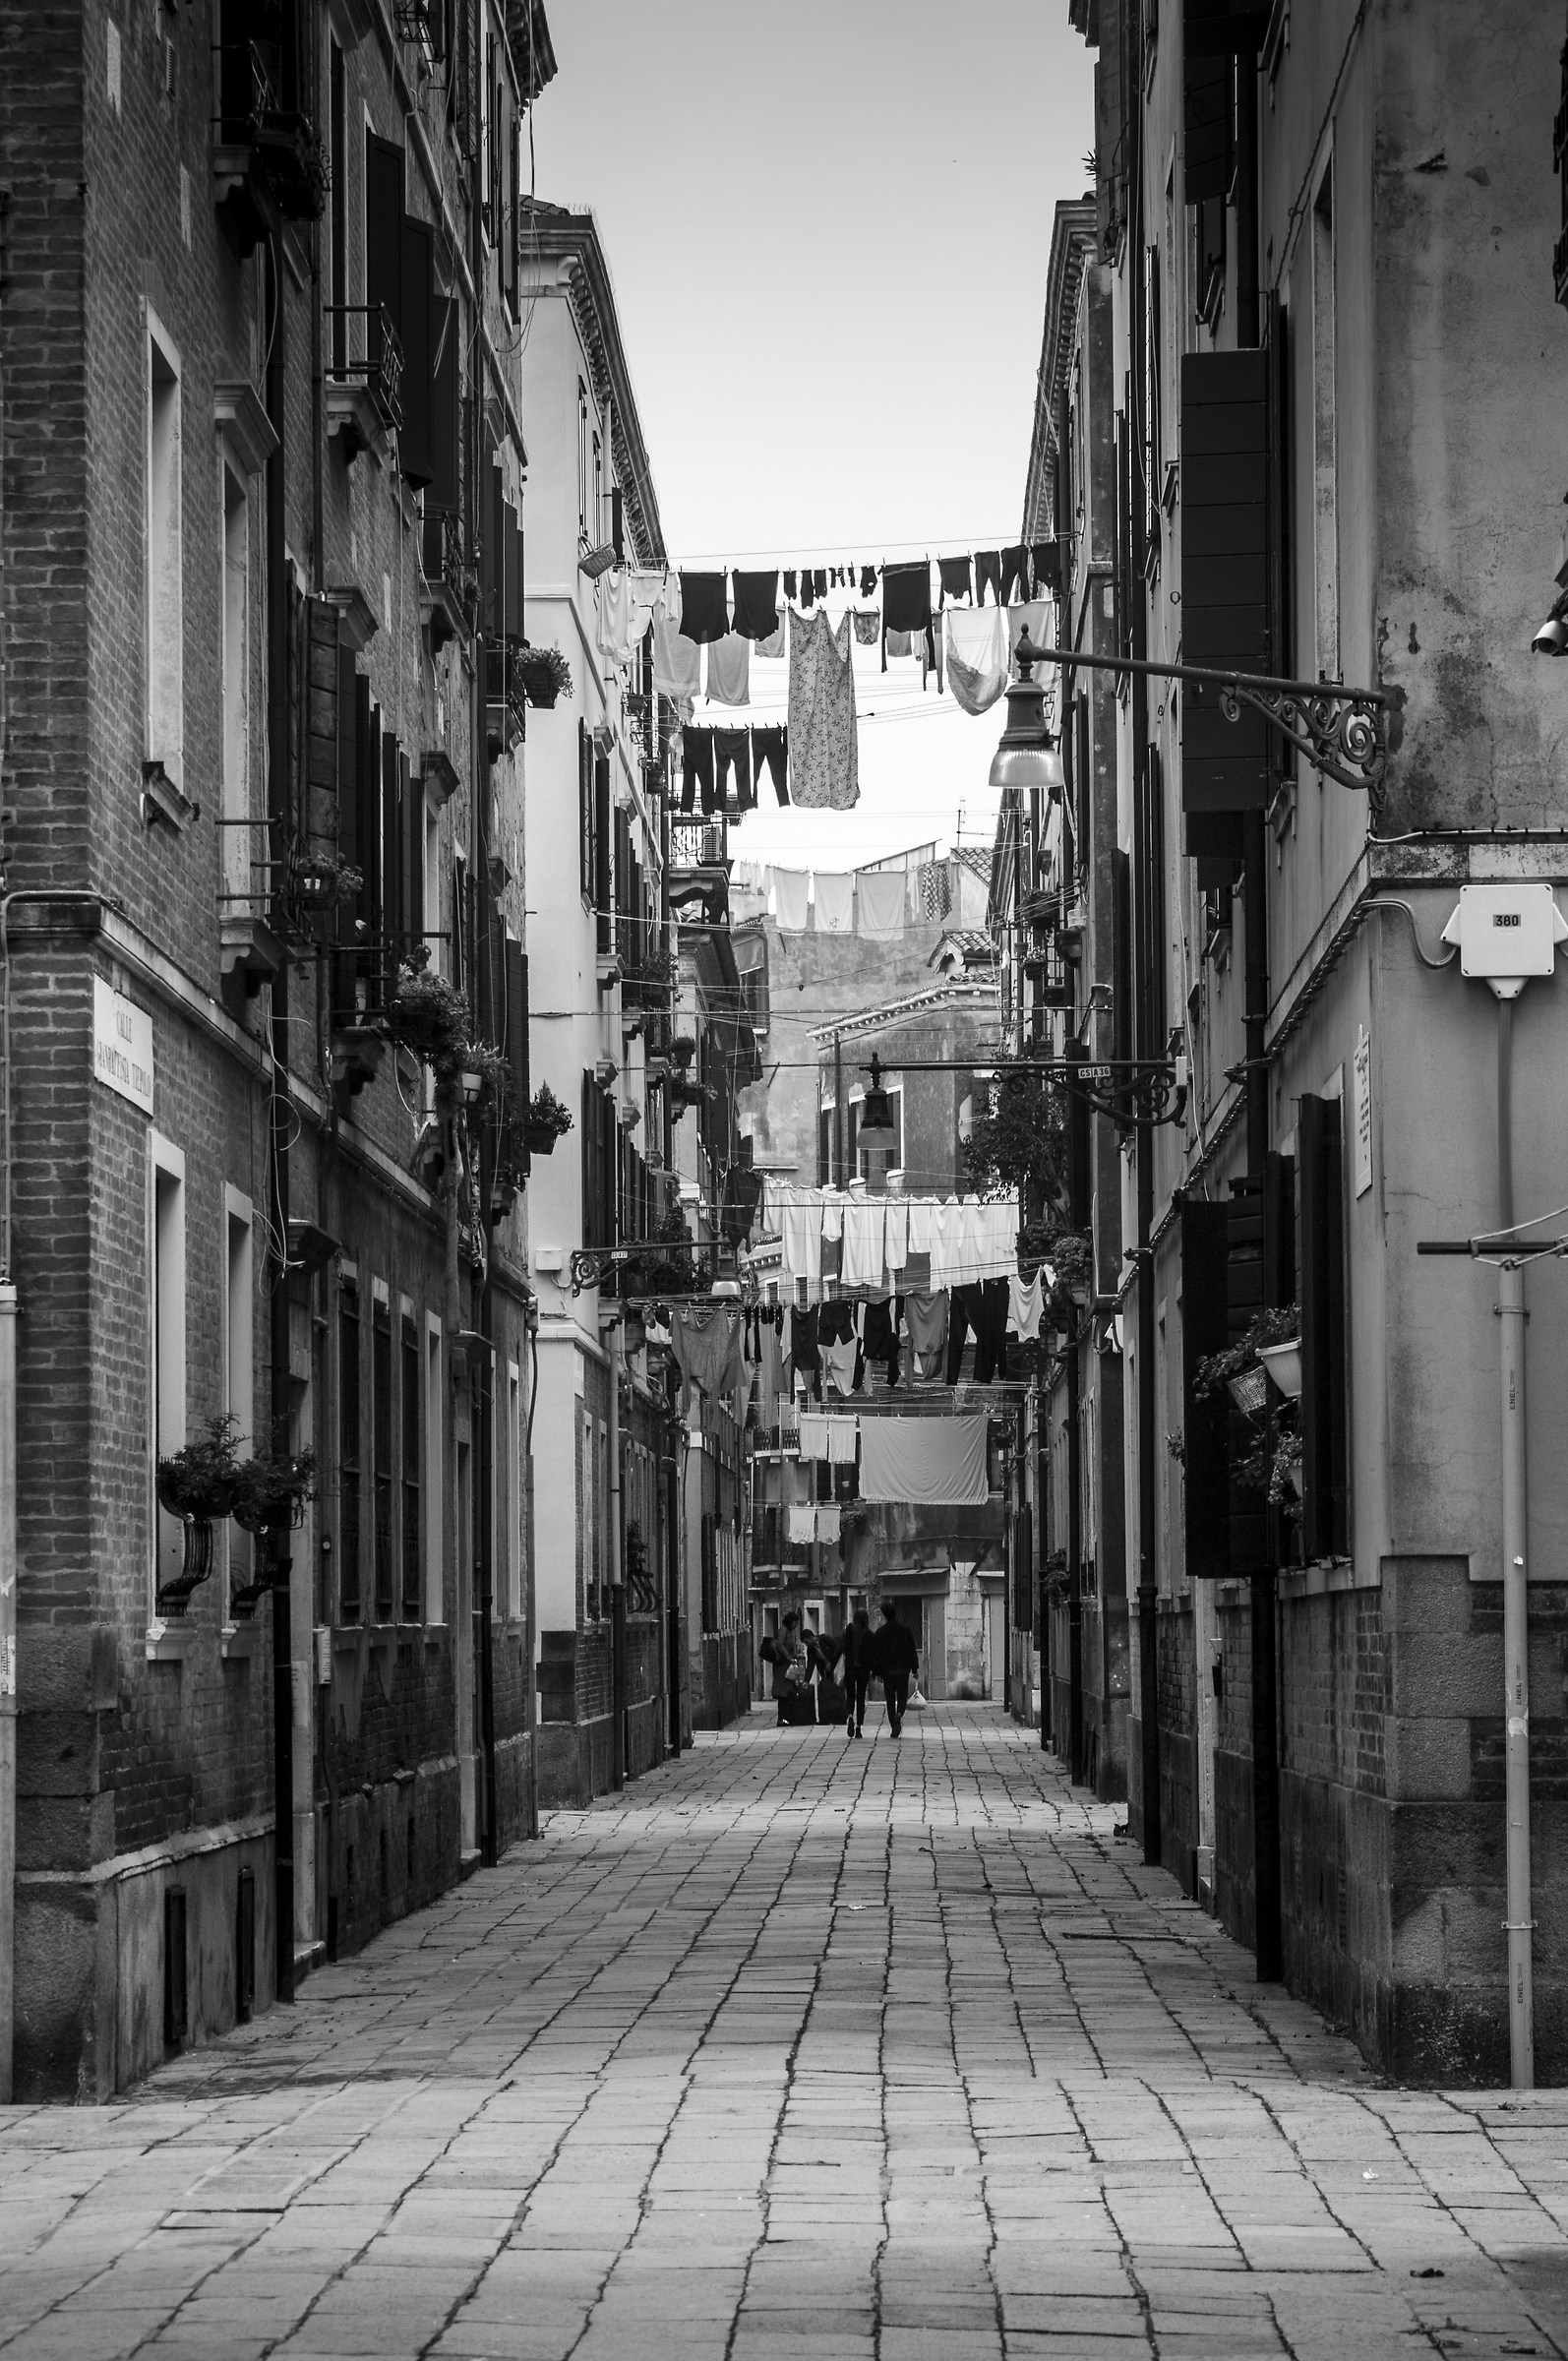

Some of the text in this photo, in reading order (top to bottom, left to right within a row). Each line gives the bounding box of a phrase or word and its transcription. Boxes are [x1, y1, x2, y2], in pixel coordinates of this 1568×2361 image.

[1495, 915, 1519, 927] 380
[116, 1009, 133, 1044] CALLE
[1080, 1066, 1110, 1077] CS A36
